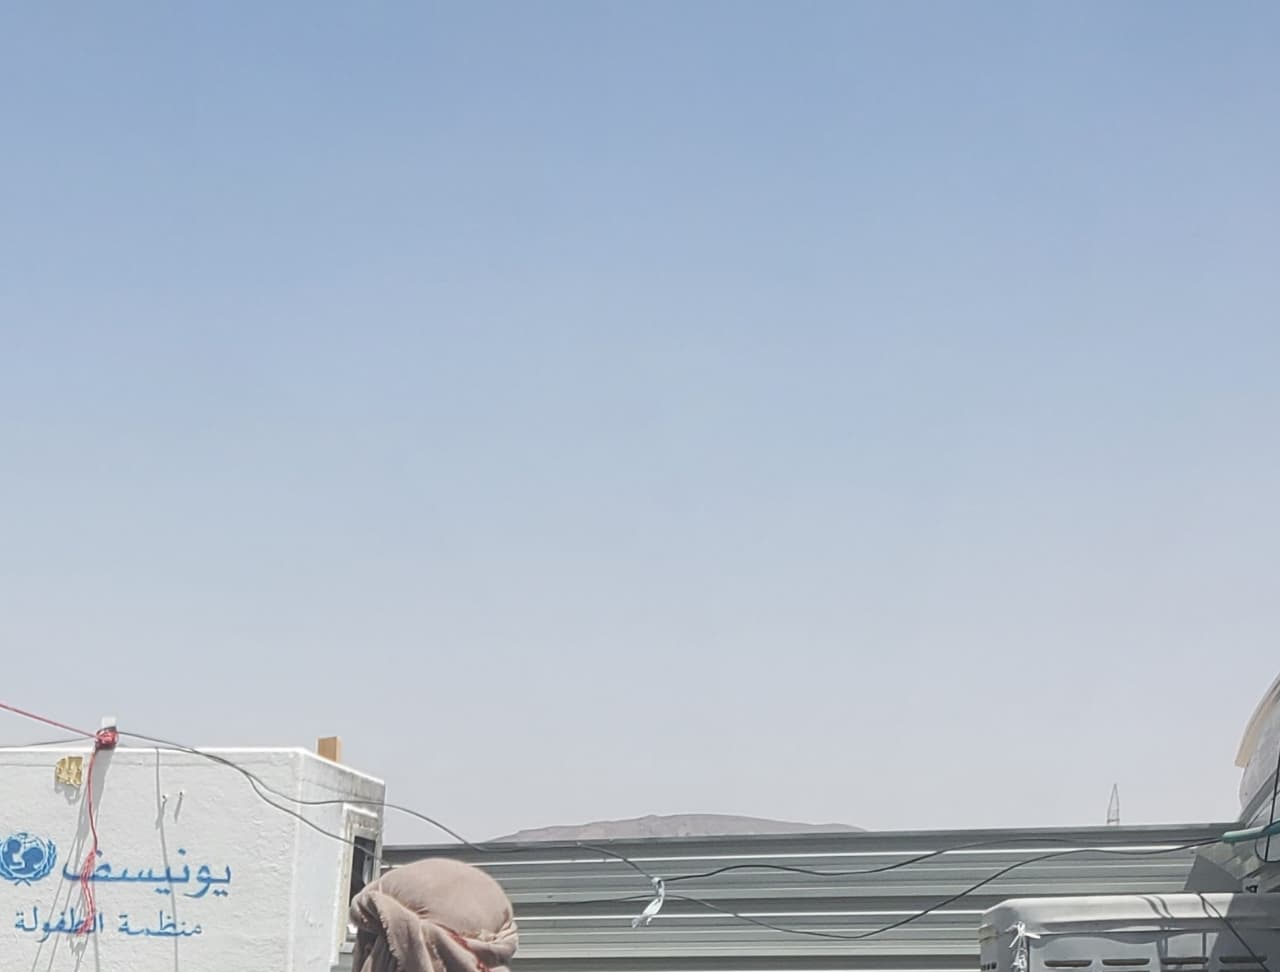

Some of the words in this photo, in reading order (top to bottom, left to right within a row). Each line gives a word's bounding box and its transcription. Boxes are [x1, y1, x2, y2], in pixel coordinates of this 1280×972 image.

[62, 848, 231, 898] يونيسف
[14, 905, 104, 944] الطفولة
[118, 910, 202, 937] منظمة
